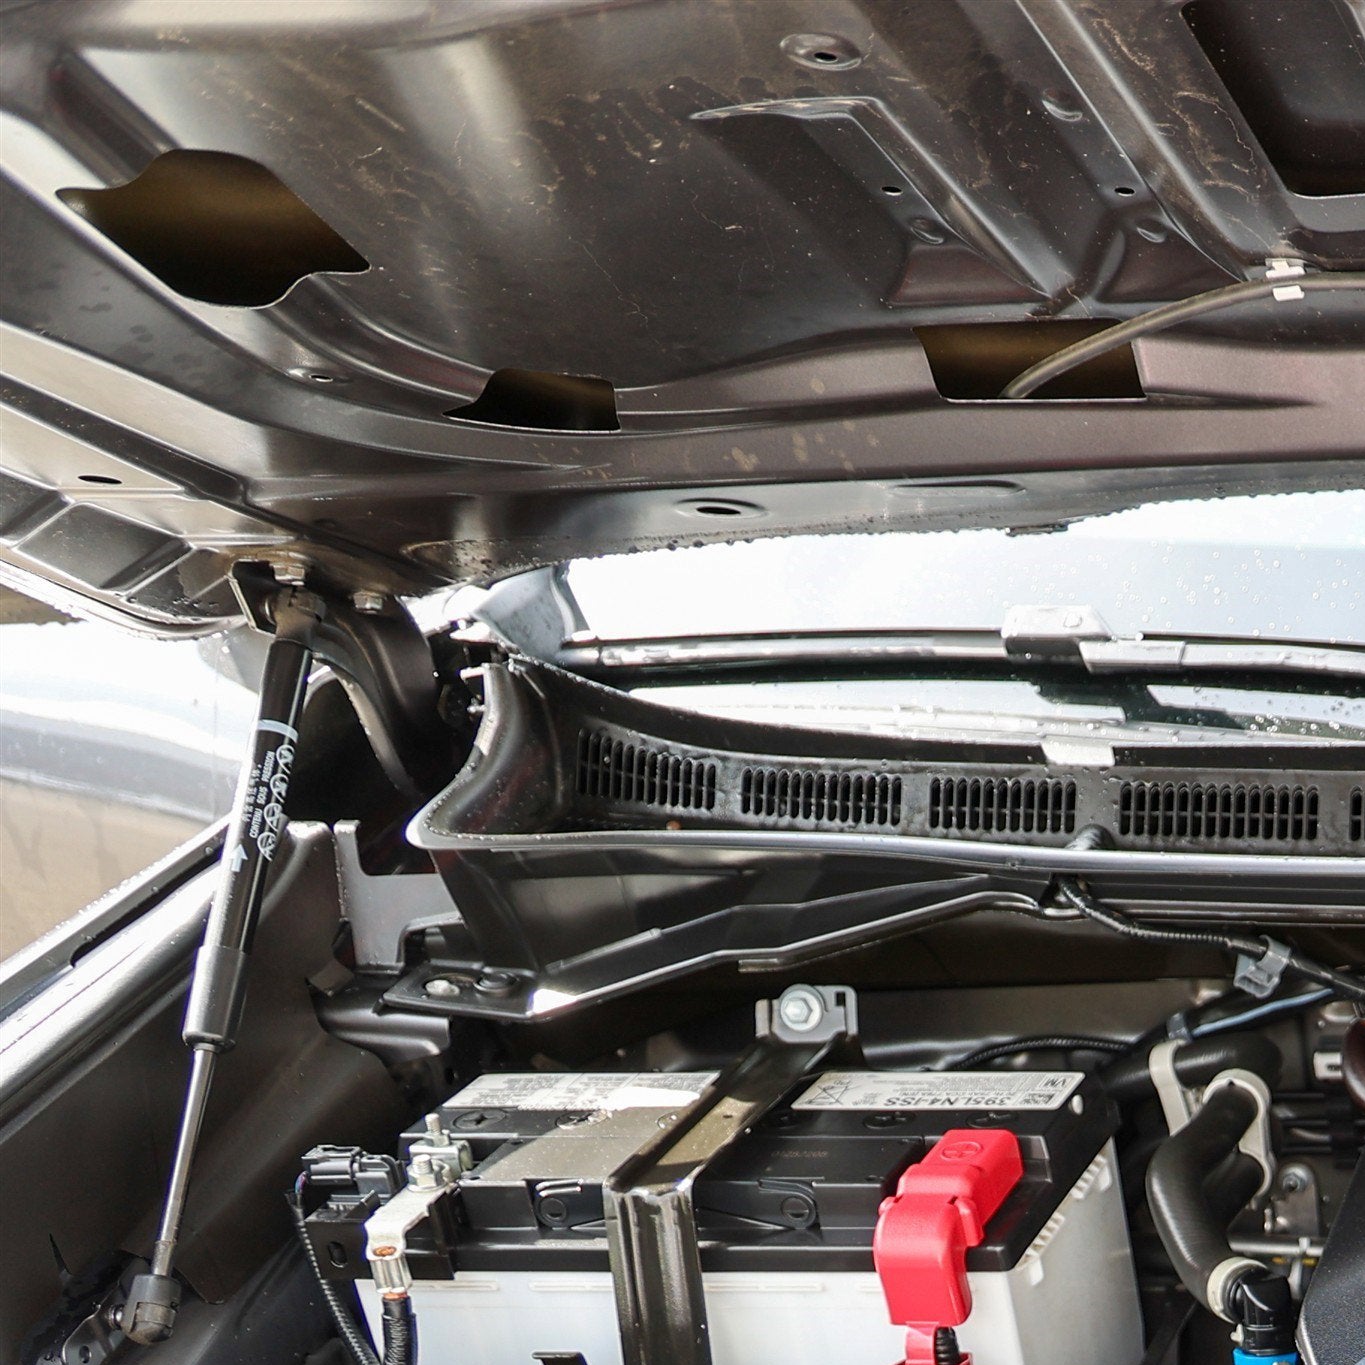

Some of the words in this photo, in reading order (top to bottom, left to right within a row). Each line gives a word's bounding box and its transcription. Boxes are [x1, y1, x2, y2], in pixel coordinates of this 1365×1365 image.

[261, 750, 275, 782] PRESSION
[256, 786, 268, 805] SOUS
[249, 808, 263, 839] CONTENU
[884, 1096, 1011, 1106] 395LN4-ISS
